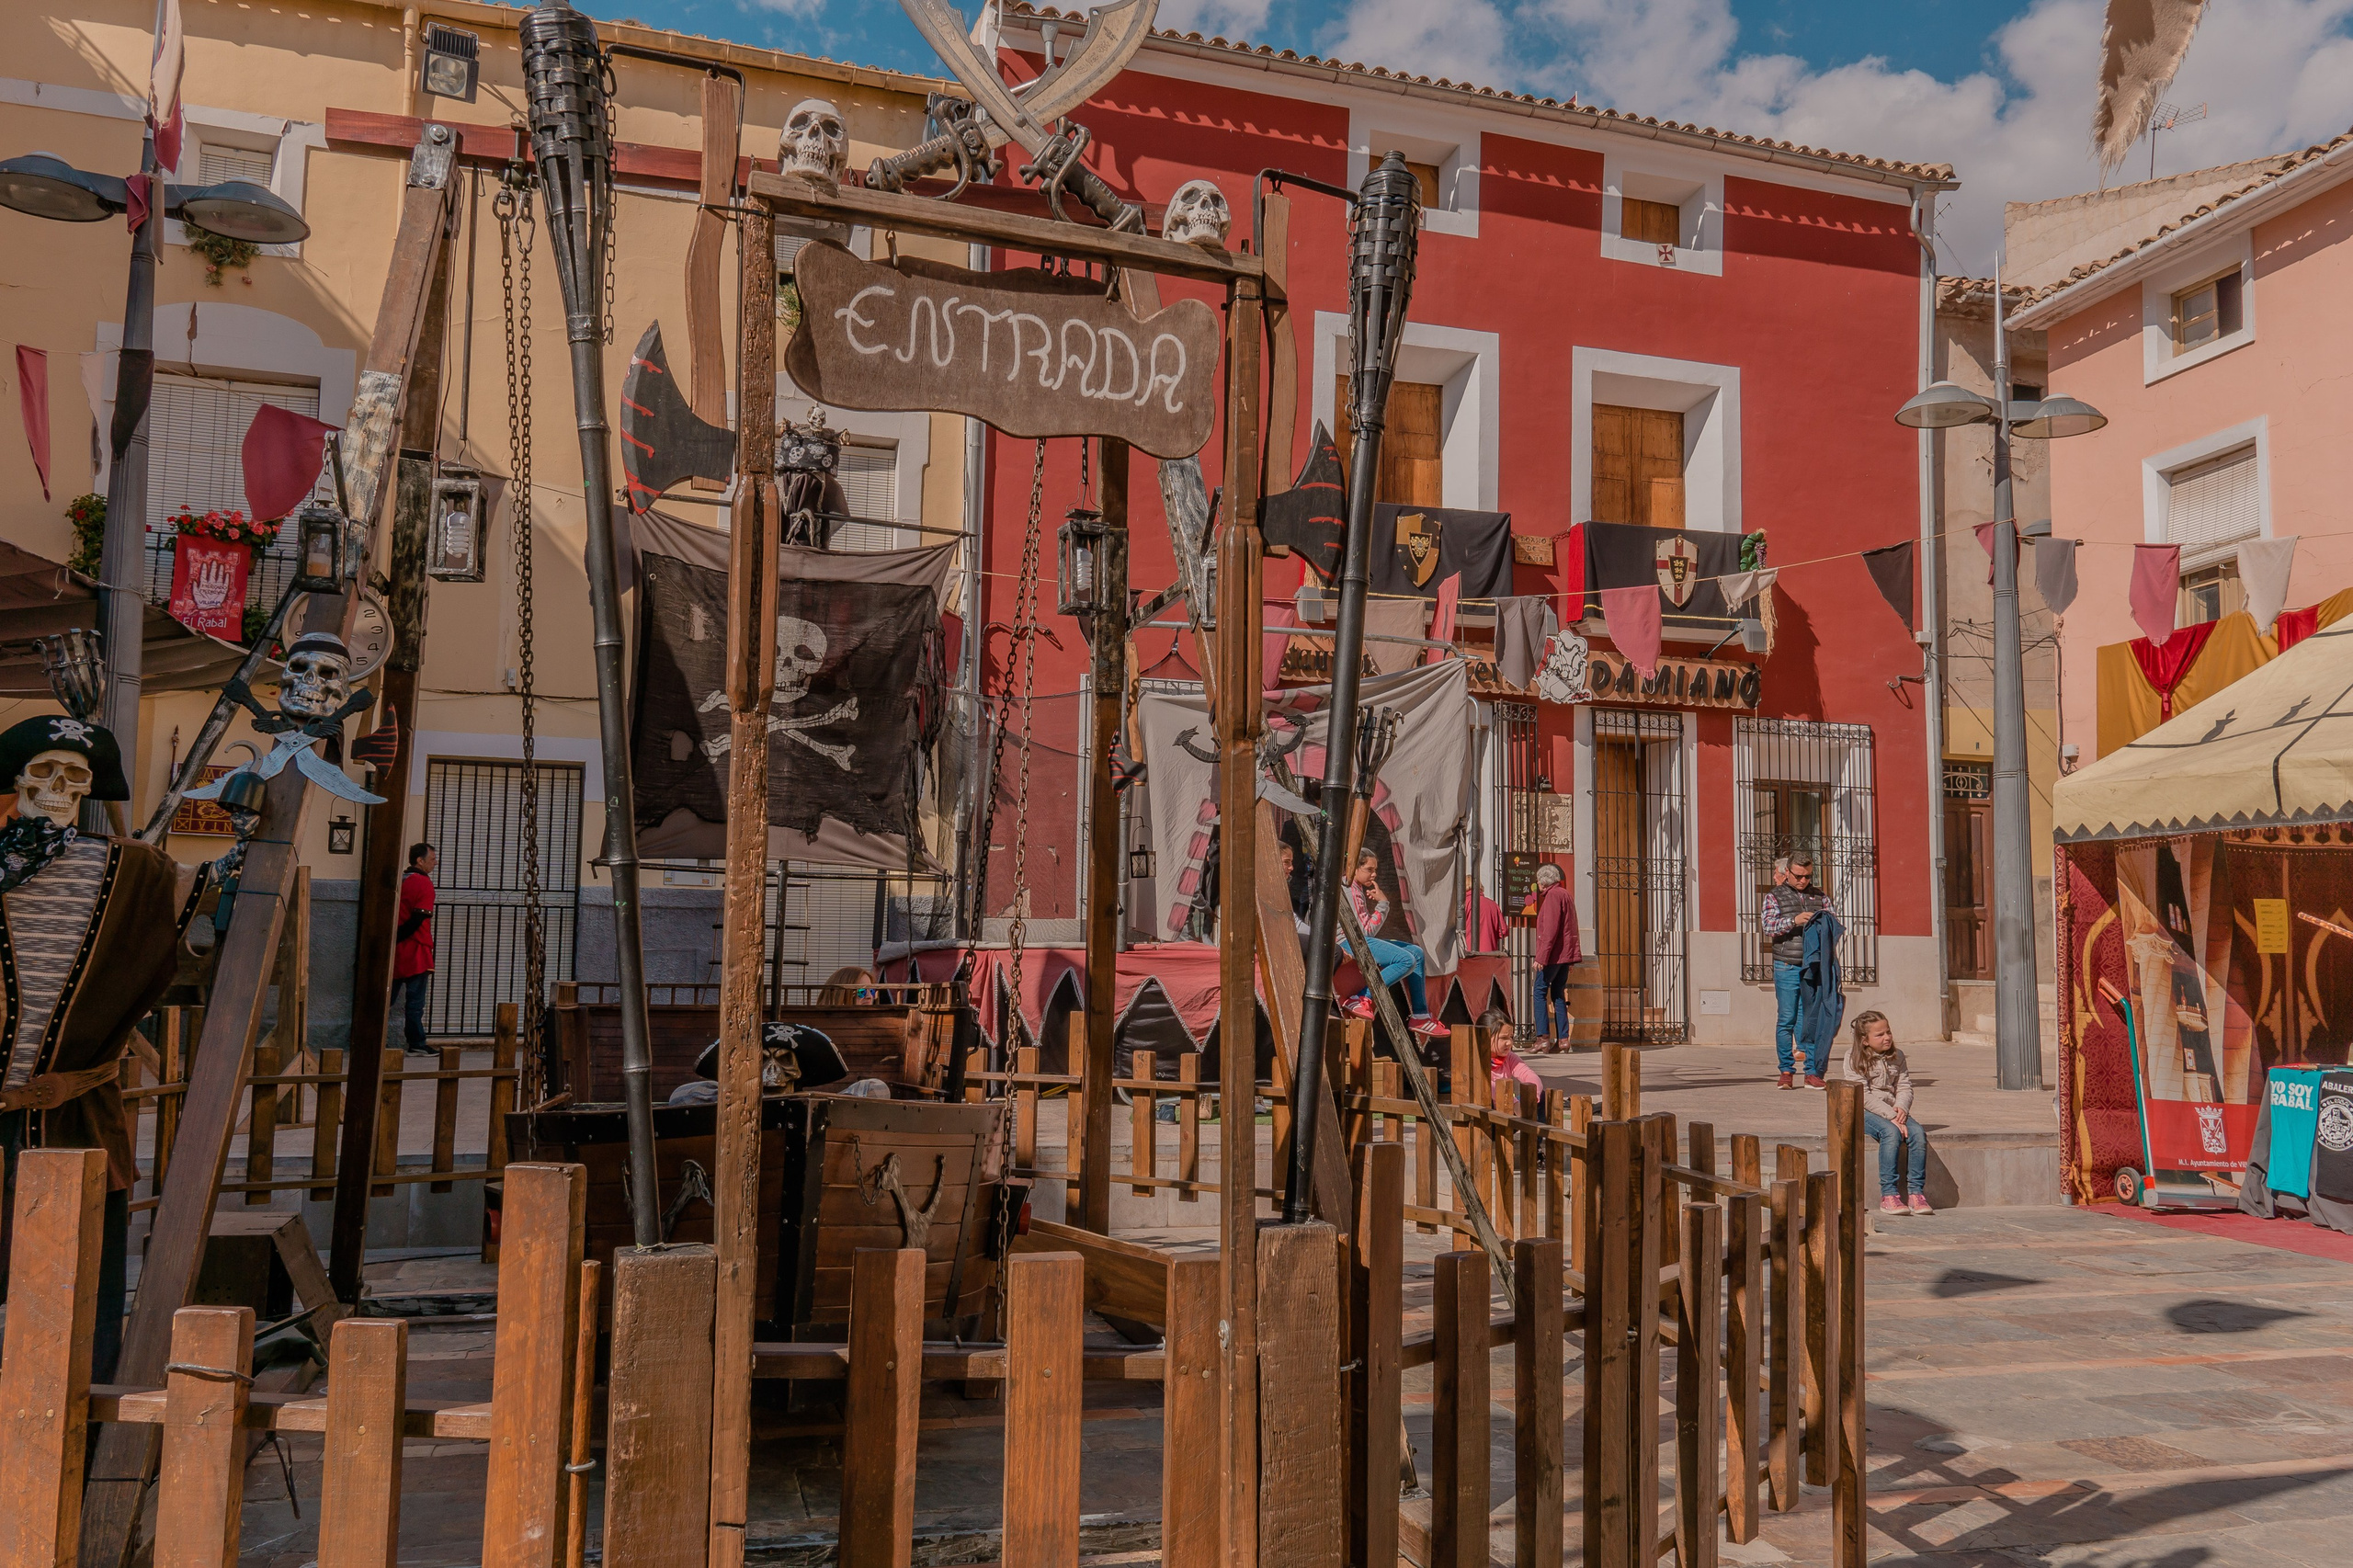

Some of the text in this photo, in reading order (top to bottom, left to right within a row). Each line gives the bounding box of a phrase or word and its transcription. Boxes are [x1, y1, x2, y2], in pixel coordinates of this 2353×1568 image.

[835, 285, 1187, 414] ENTRADA
[363, 608, 377, 618] 2
[183, 617, 227, 632] El Rabal
[370, 625, 383, 634] 3
[368, 642, 380, 652] 4
[356, 656, 368, 665] 5
[1590, 660, 1761, 706] DAMIANO
[2269, 1081, 2313, 1098] YO SOY
[2270, 1093, 2313, 1111] RABAL
[2190, 1159, 2229, 1168] Ayuntamiento
